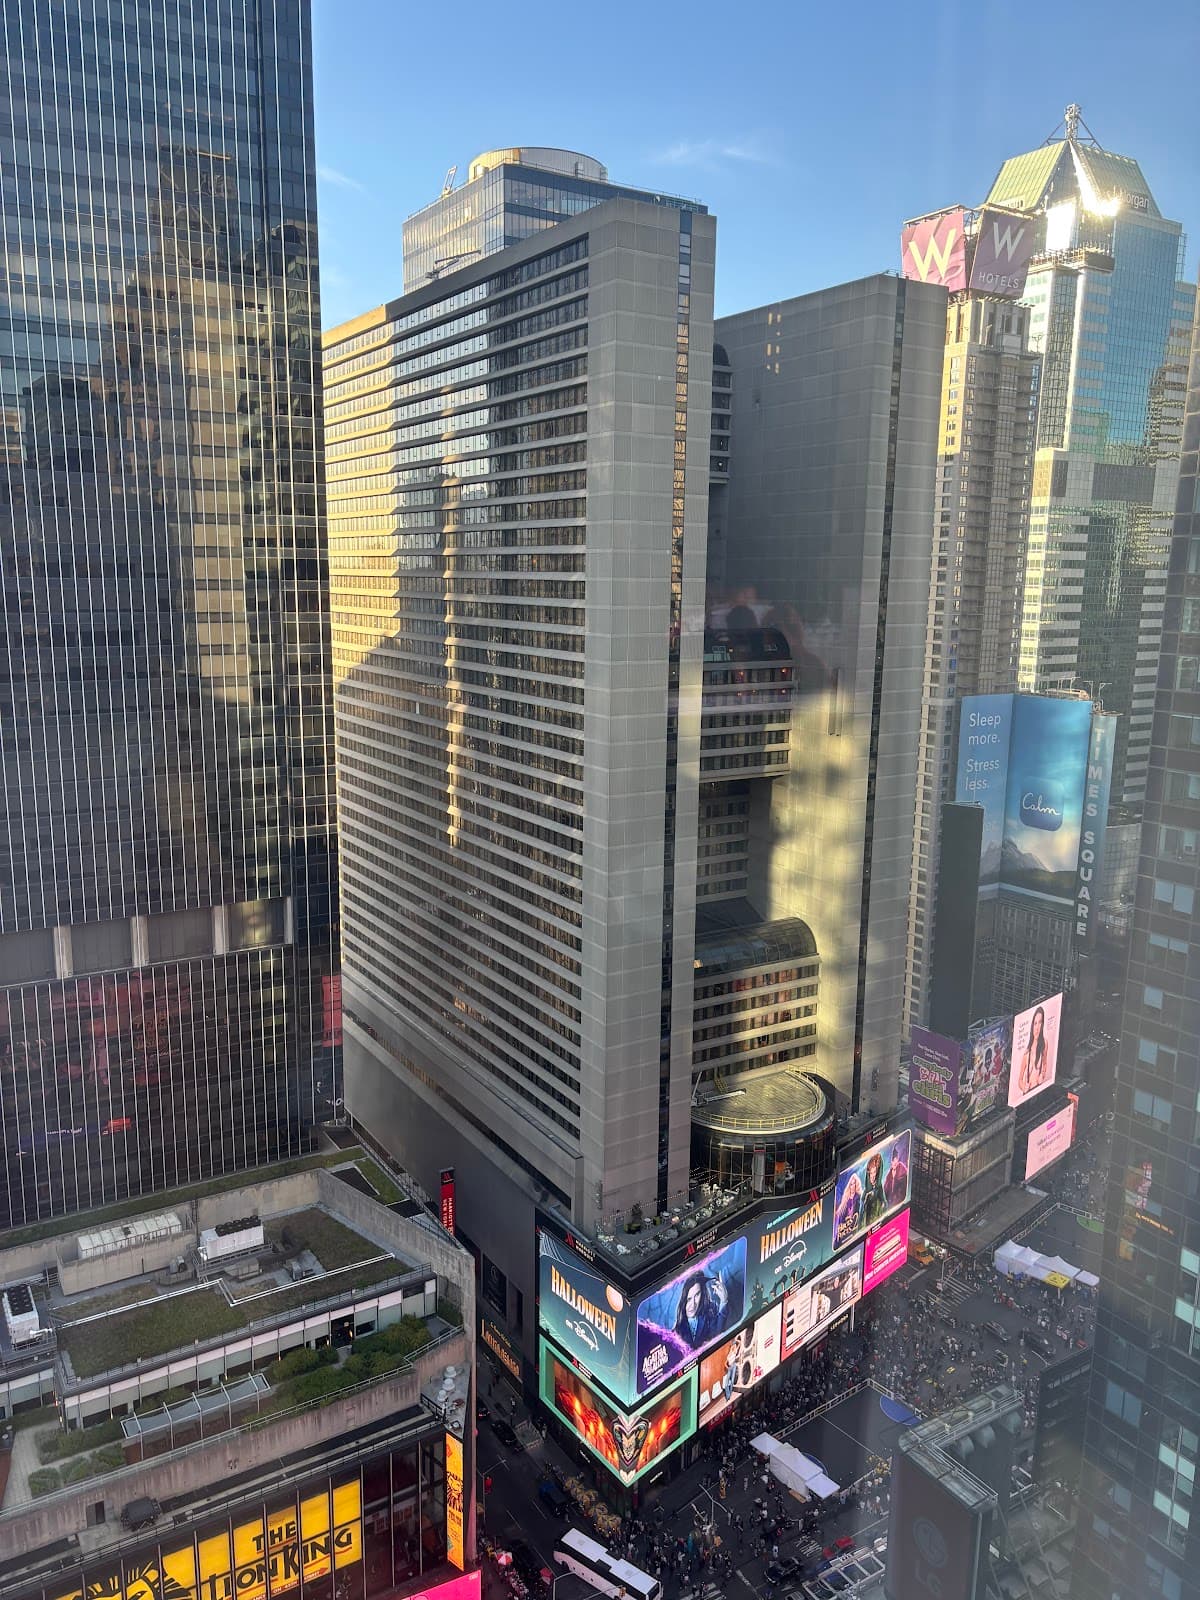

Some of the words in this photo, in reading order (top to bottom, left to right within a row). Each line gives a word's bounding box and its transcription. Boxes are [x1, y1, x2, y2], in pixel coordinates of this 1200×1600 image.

[908, 228, 957, 281] W
[992, 221, 1025, 263] W
[979, 272, 1020, 289] HOTELS
[968, 712, 1001, 729] Sleep
[967, 733, 1001, 745] more.
[964, 776, 990, 791] less.
[966, 758, 1000, 773] Stress
[1086, 728, 1105, 817] TIMES
[1022, 792, 1061, 816] Calm
[1076, 831, 1096, 936] SQUARE
[760, 1198, 823, 1264] HALLOWEEN
[551, 1264, 617, 1346] HALLOWEEN
[252, 1520, 297, 1551] THE
[208, 1557, 279, 1600] LION
[280, 1527, 353, 1580] KING
